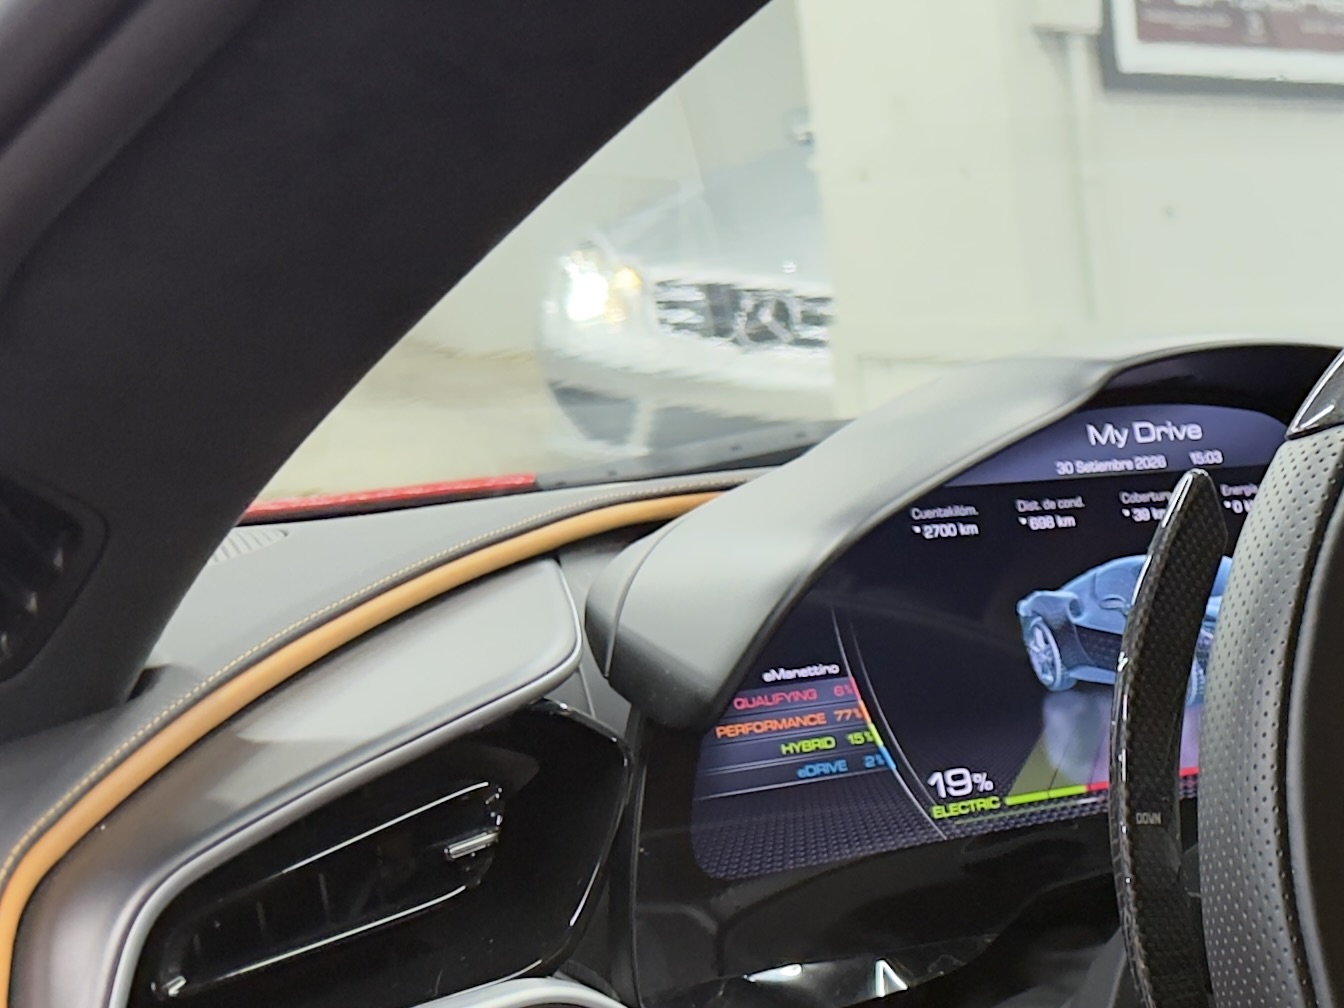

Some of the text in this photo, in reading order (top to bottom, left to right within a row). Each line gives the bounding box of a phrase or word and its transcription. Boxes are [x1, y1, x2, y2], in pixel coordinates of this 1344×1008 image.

[1086, 421, 1202, 448] My Drive
[1055, 461, 1074, 475] 30
[1189, 449, 1222, 465] 15:03
[1017, 496, 1085, 512] Dist. de cond.
[1120, 491, 1172, 505] Cobertur
[922, 522, 979, 539] 2700 km
[1055, 514, 1076, 528] km
[762, 662, 840, 683] eManettino
[733, 688, 818, 711] QUALIFYING
[715, 712, 827, 739] PERFORMANCE
[780, 735, 836, 756] HYBRID
[796, 759, 849, 778] eDRIVE
[927, 767, 995, 799] 19%
[930, 795, 1001, 820] ELECTRIC
[1135, 811, 1162, 825] DOWN
